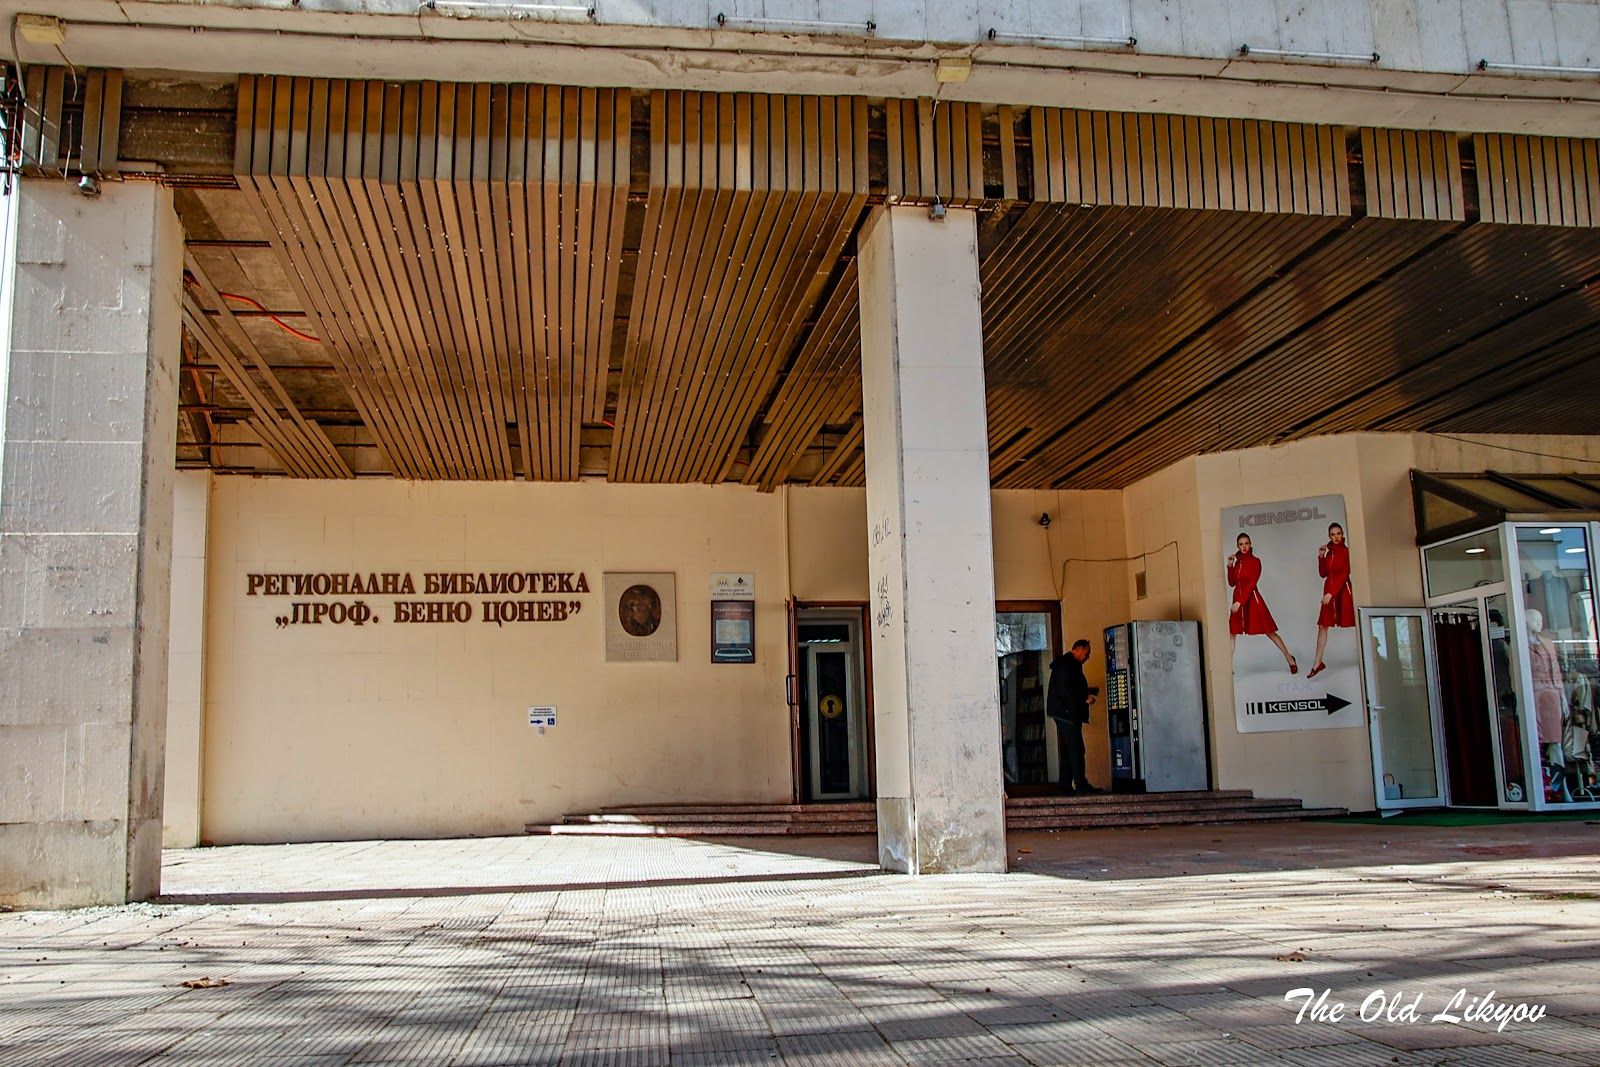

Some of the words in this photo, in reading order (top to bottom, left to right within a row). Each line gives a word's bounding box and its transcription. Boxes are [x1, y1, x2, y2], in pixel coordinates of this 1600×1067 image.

[1239, 507, 1326, 528] KENSOL
[246, 573, 416, 597] РЕГИОНАЛНА
[424, 571, 591, 595] БИБЛИОТЕКА
[393, 600, 472, 625] БЕНЮ
[1269, 700, 1326, 712] KENSOL
